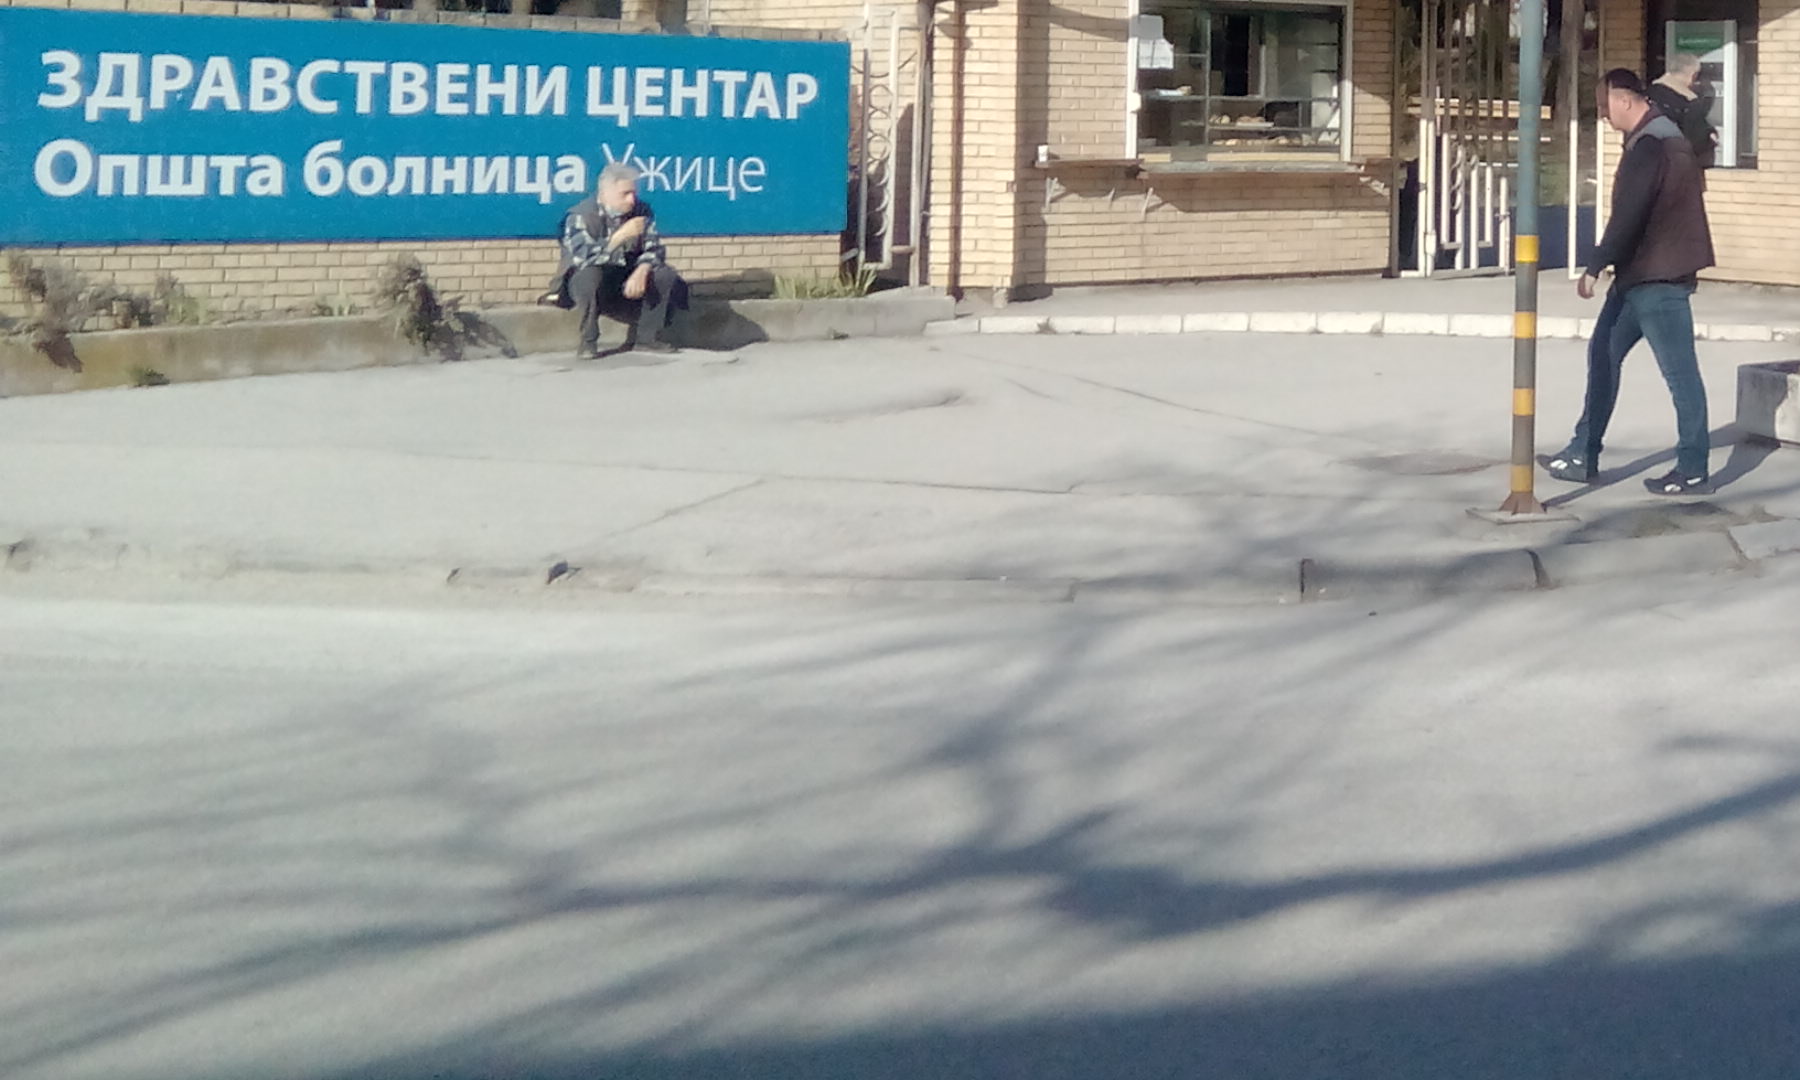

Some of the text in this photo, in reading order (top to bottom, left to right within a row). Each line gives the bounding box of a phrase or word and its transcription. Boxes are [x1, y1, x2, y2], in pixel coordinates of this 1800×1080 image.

[38, 50, 818, 127] ЗДРАВСТВЕНИ ЦЕНТАР
[34, 139, 284, 197] Општа
[303, 140, 586, 204] болница
